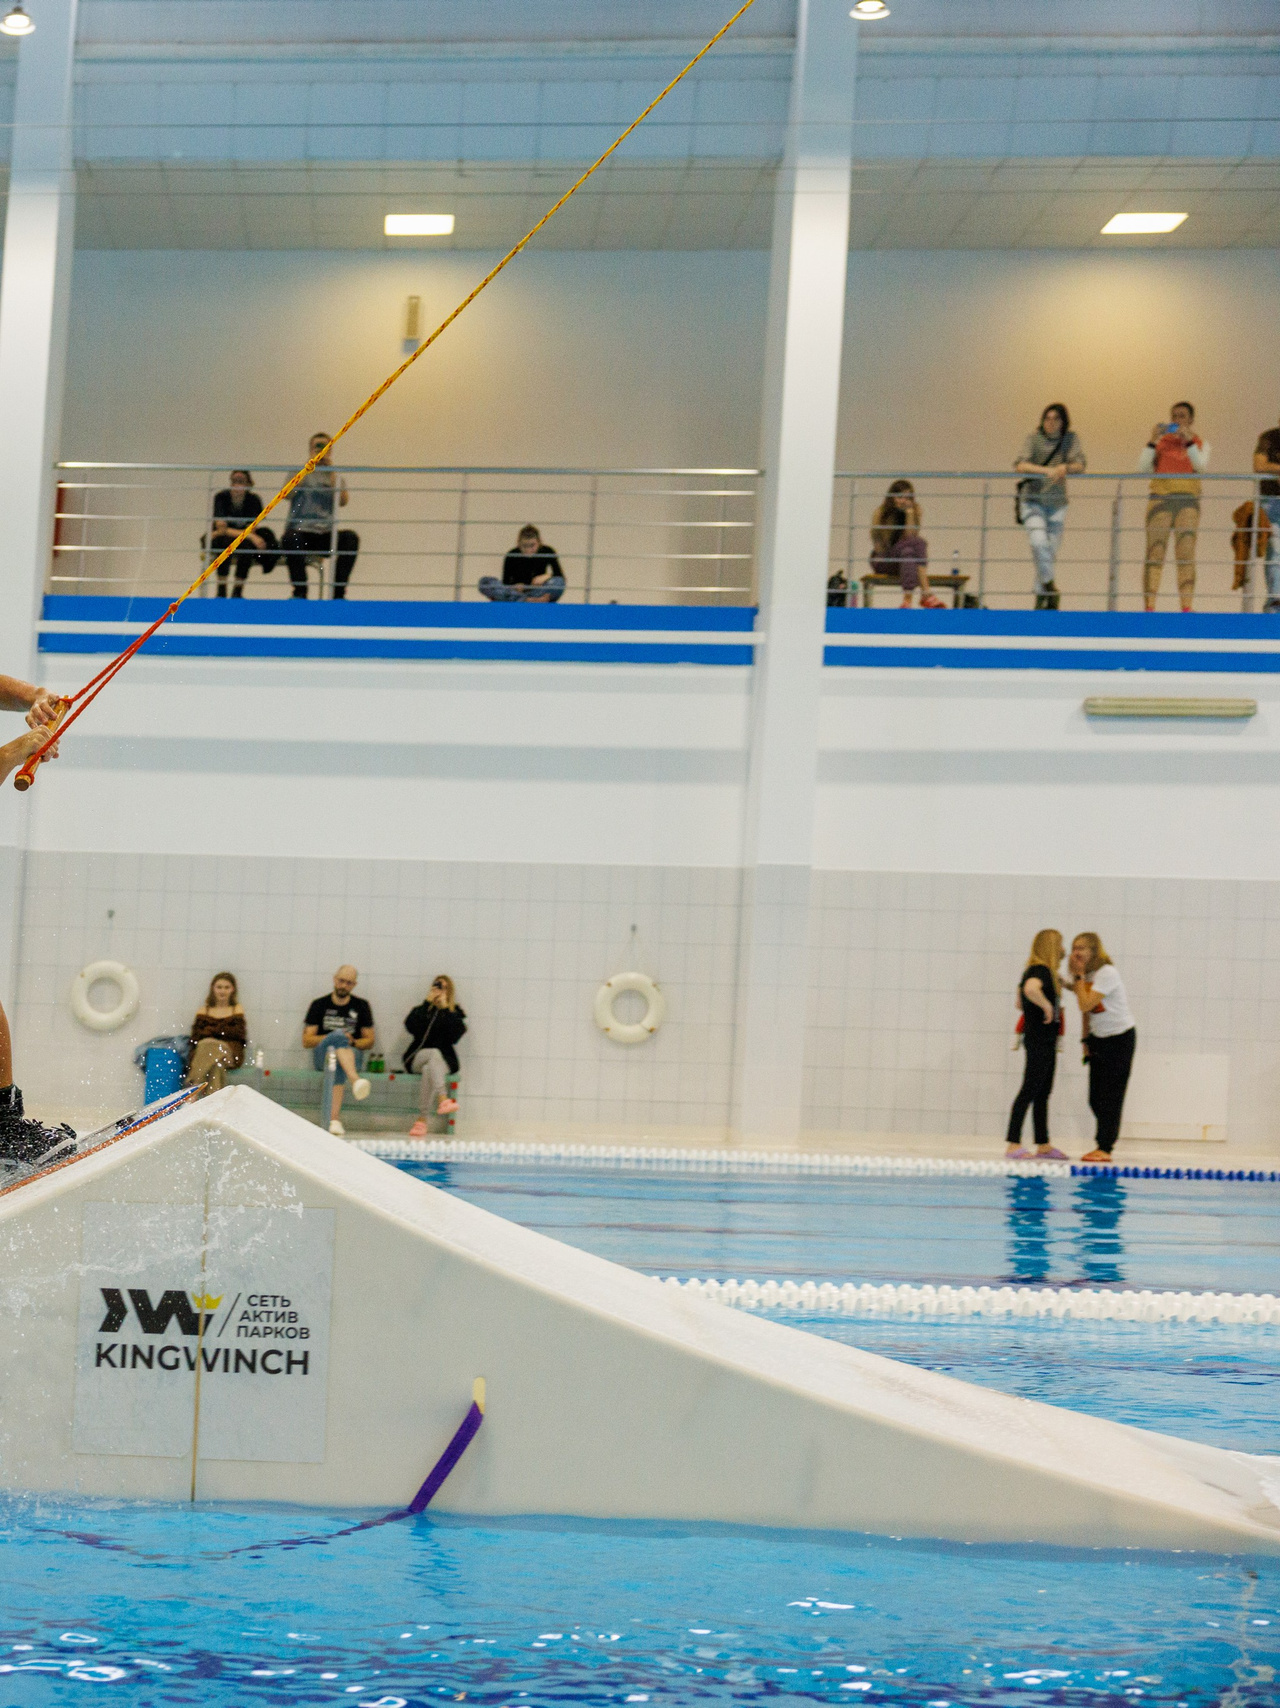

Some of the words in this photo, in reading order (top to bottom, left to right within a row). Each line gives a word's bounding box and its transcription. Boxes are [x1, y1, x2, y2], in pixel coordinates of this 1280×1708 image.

[247, 1294, 291, 1308] СЕТЬ
[239, 1309, 299, 1324] АКТИВ
[236, 1325, 311, 1340] ПАРКОВ
[95, 1342, 310, 1375] KINGWINCH
